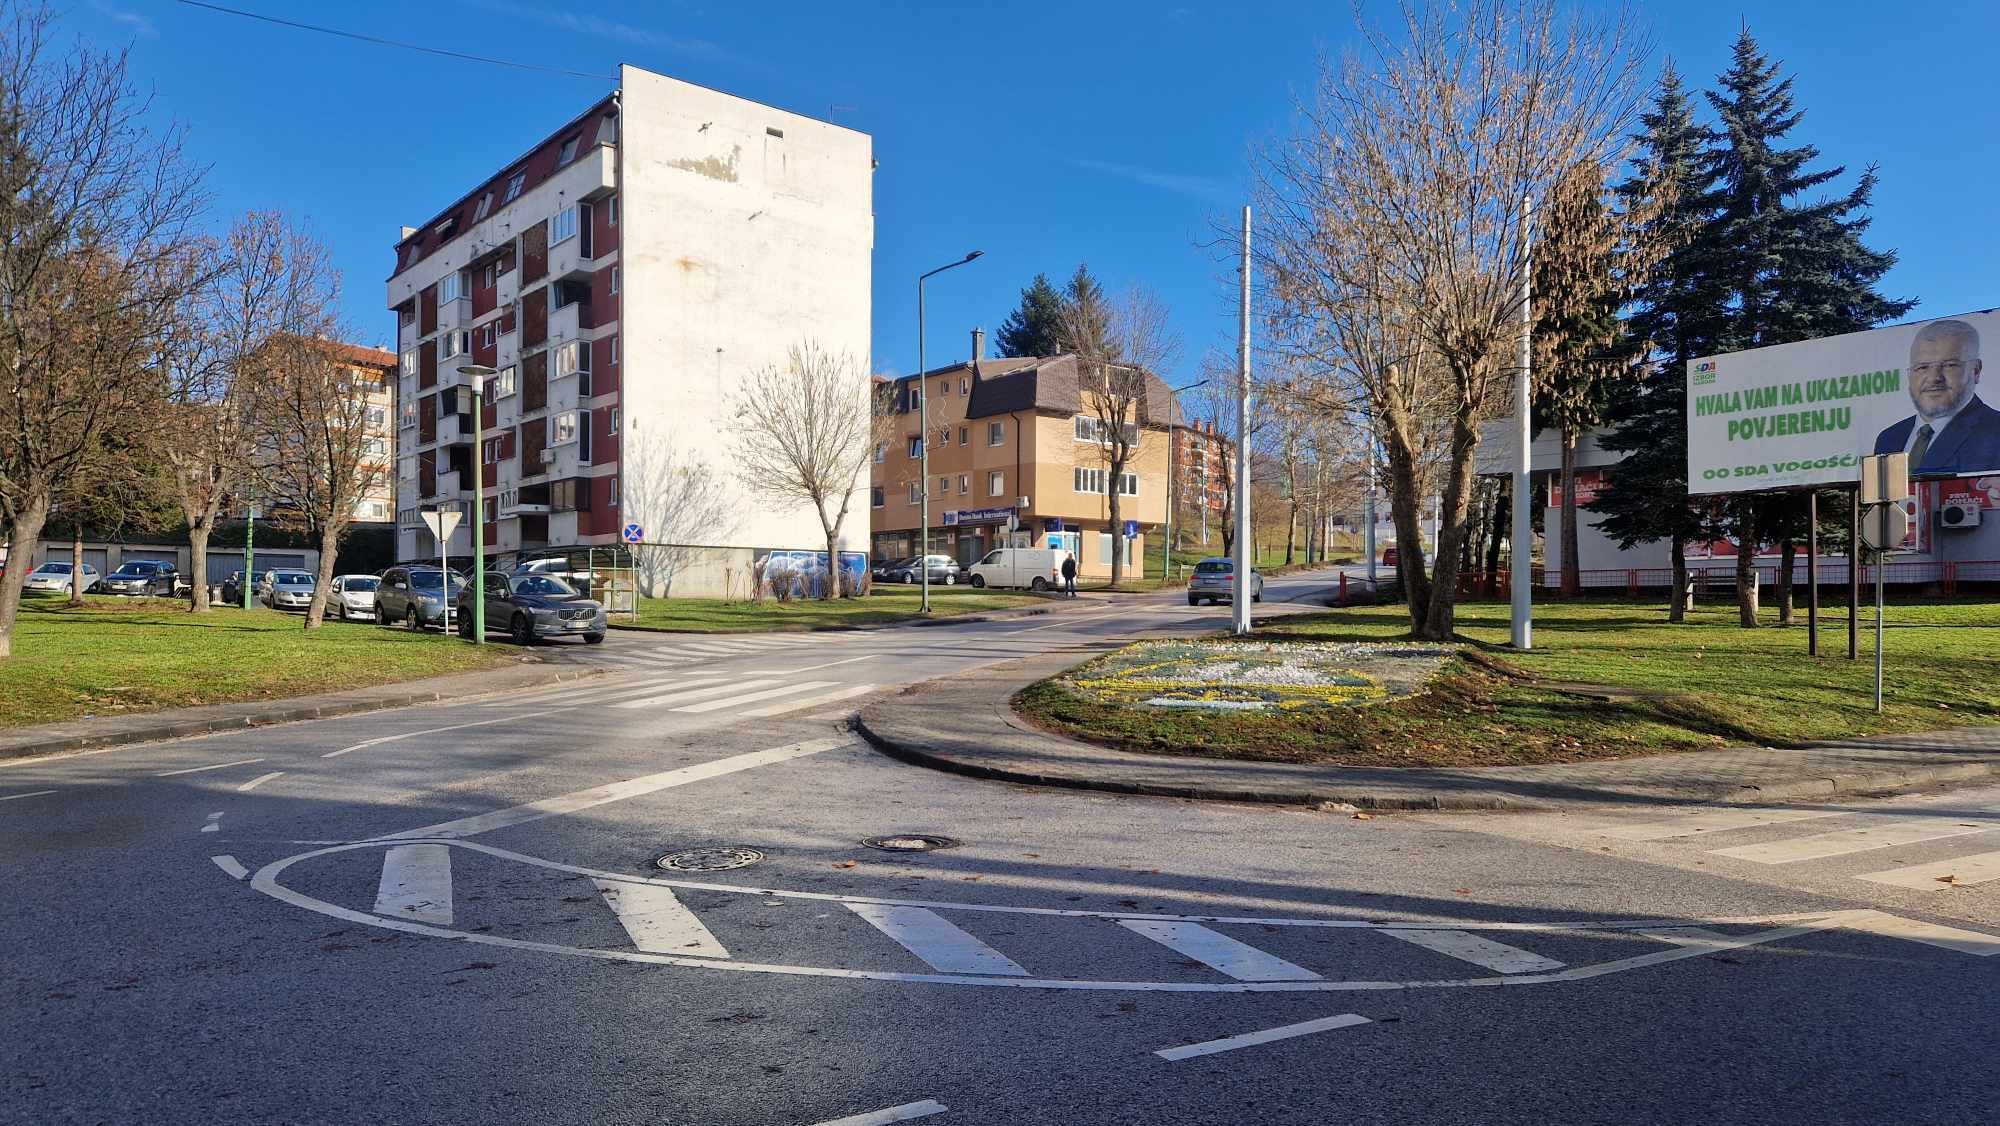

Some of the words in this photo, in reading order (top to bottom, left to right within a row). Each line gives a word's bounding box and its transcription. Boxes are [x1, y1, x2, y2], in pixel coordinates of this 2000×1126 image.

[1695, 361, 1717, 373] SDA
[1696, 392, 1742, 417] HVALA
[1744, 385, 1778, 411] VAM
[1781, 383, 1802, 406] NA
[1806, 368, 1900, 403] UKAZANOM
[1727, 406, 1851, 442] POVJERENJU
[1703, 468, 1730, 480] OO
[1734, 464, 1769, 477] SDA
